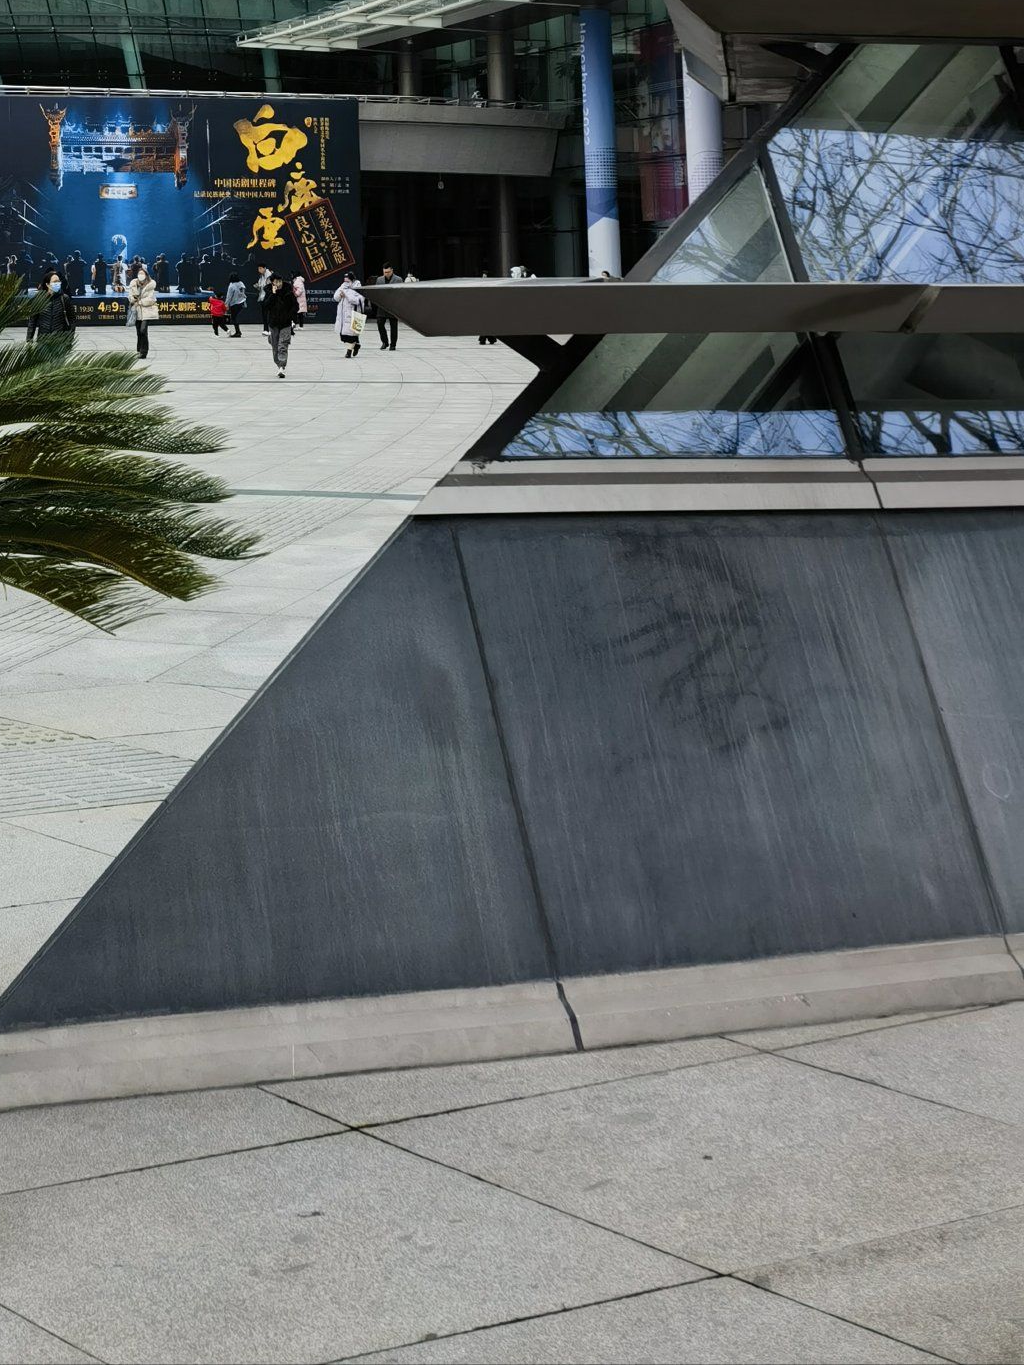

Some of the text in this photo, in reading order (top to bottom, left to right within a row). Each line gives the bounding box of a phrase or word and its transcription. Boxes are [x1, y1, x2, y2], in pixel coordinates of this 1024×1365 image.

[214, 178, 277, 188] 中国话剧里程碑
[294, 215, 327, 275] 良心巨制
[315, 205, 347, 265] 茅奖纪念版
[97, 301, 126, 313] 4月9日
[155, 301, 213, 312] 州大剧院·歌
